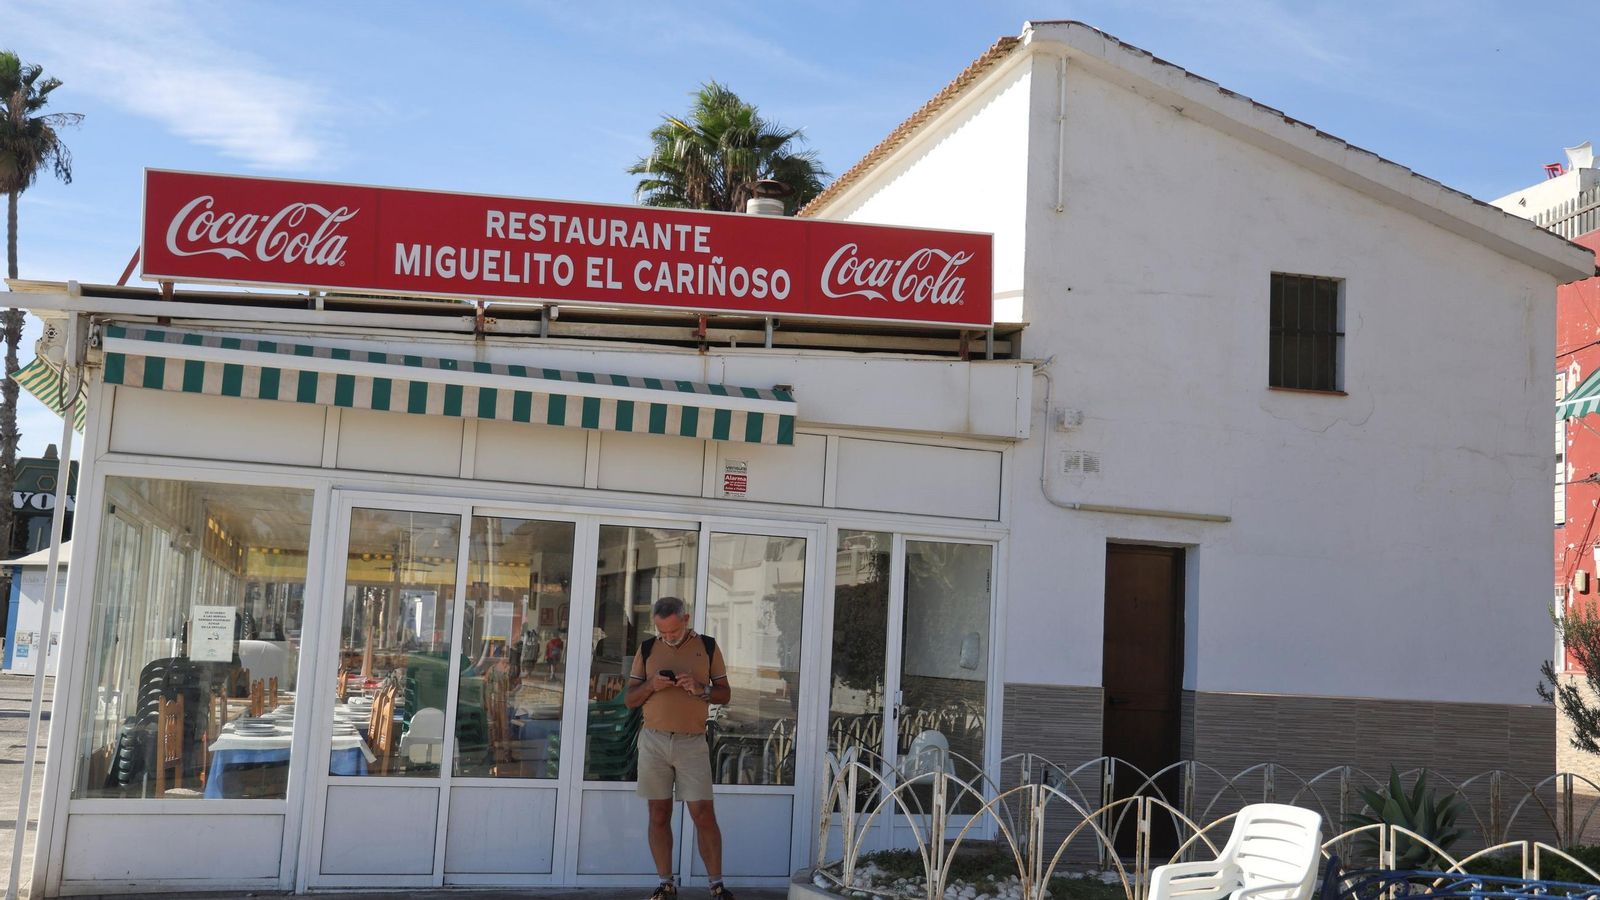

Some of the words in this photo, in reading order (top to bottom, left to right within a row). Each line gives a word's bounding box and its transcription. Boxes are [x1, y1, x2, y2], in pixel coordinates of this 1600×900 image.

[165, 195, 361, 266] Coca-Cola
[486, 209, 711, 254] RESTAURANTE
[394, 242, 575, 287] MIGUELITO
[586, 257, 623, 290] EL
[634, 257, 791, 301] CARIÑOSO
[820, 243, 975, 305] Coca-Cola
